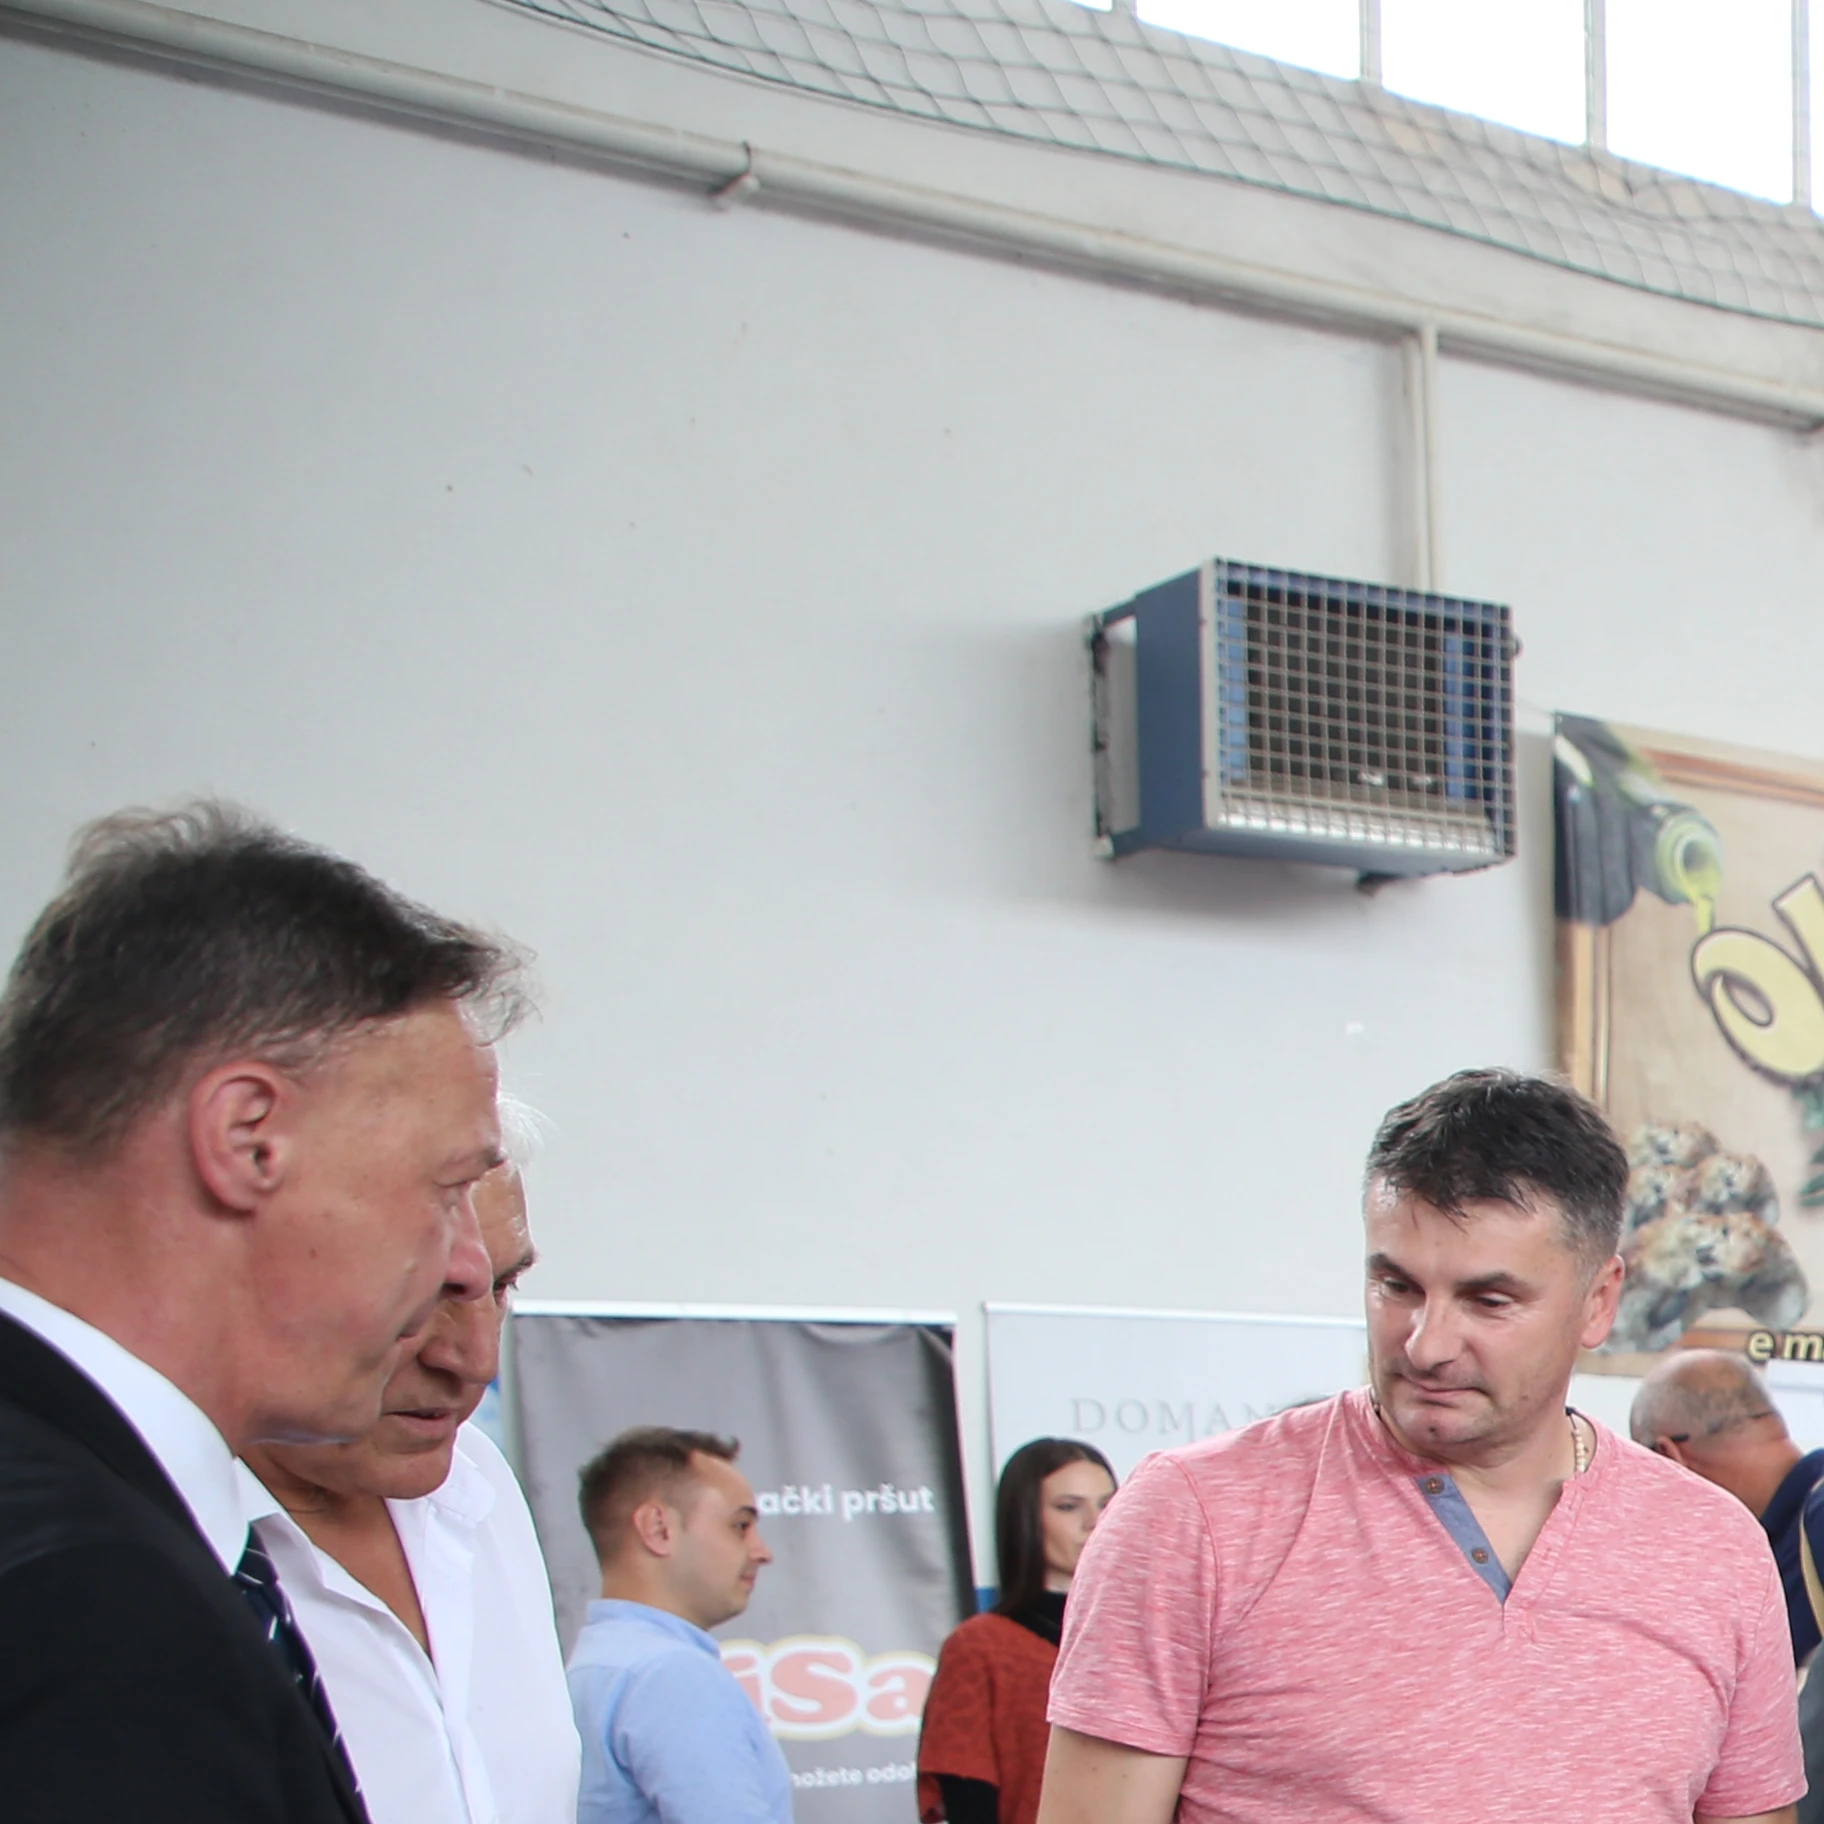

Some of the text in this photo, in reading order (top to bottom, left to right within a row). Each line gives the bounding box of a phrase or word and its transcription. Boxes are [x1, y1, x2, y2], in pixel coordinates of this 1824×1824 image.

[1748, 1334, 1774, 1361] e
[756, 1481, 936, 1523] ački pršut
